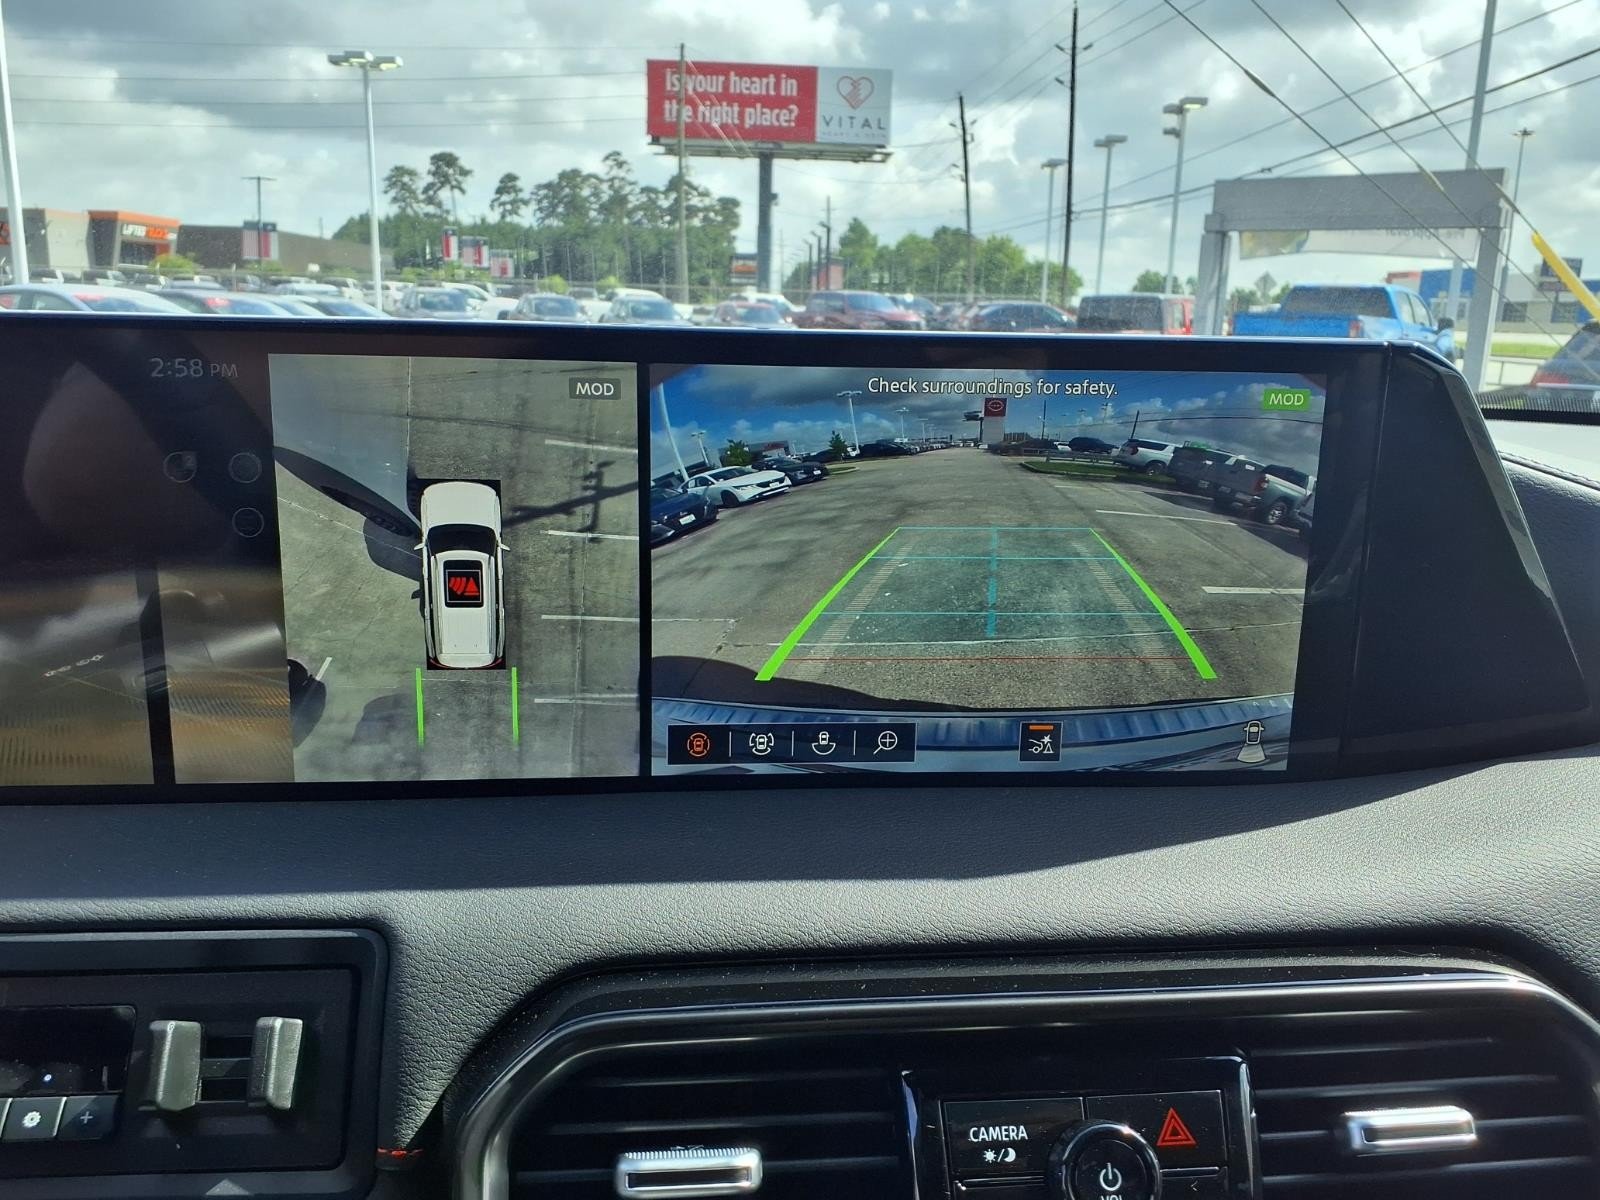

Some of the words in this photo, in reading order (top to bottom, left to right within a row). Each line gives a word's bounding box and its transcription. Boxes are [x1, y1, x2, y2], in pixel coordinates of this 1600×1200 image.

[665, 68, 681, 92] Is
[685, 73, 726, 95] your
[729, 71, 776, 96] heart
[780, 73, 798, 97] in
[697, 100, 740, 126] right
[744, 102, 799, 128] place?
[822, 114, 887, 130] VITAL
[150, 357, 204, 378] 2:58
[209, 363, 239, 377] PM
[575, 382, 615, 396] MOD
[868, 377, 918, 393] Check
[922, 378, 1032, 398] surroundings
[1037, 378, 1061, 394] for
[1065, 379, 1118, 398] safety.
[1269, 393, 1304, 406] MOD
[969, 1125, 1029, 1142] CAMERA
